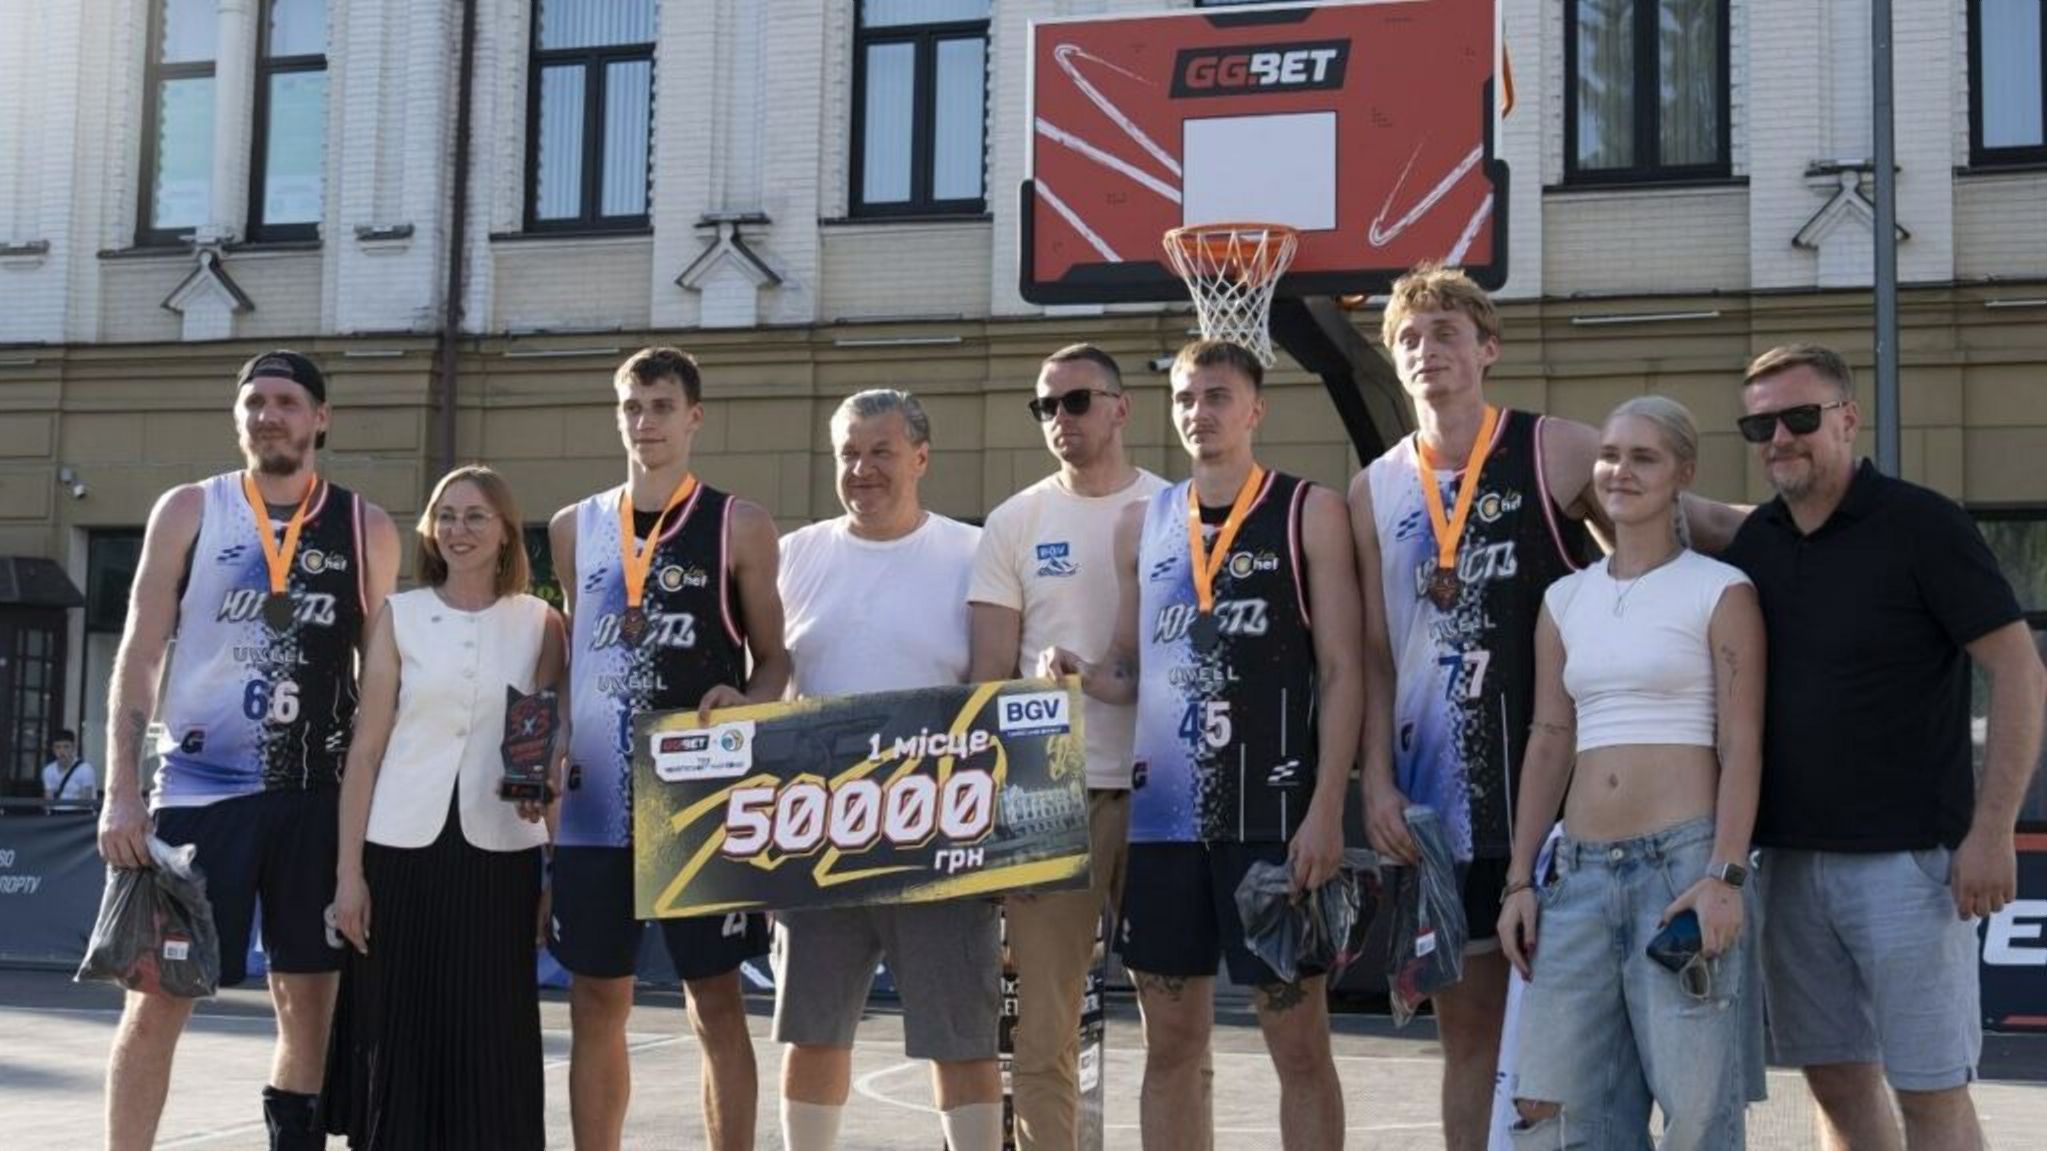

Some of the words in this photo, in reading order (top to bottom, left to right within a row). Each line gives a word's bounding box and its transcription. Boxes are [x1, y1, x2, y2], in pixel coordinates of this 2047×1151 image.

[1185, 49, 1338, 89] GG.BET
[1437, 650, 1490, 700] 77
[243, 679, 300, 724] 66
[1007, 700, 1059, 722] BGV
[868, 733, 881, 760] 1
[894, 727, 990, 759] місце
[1179, 701, 1232, 748] 45
[722, 769, 994, 855] 50000
[934, 847, 985, 873] грн
